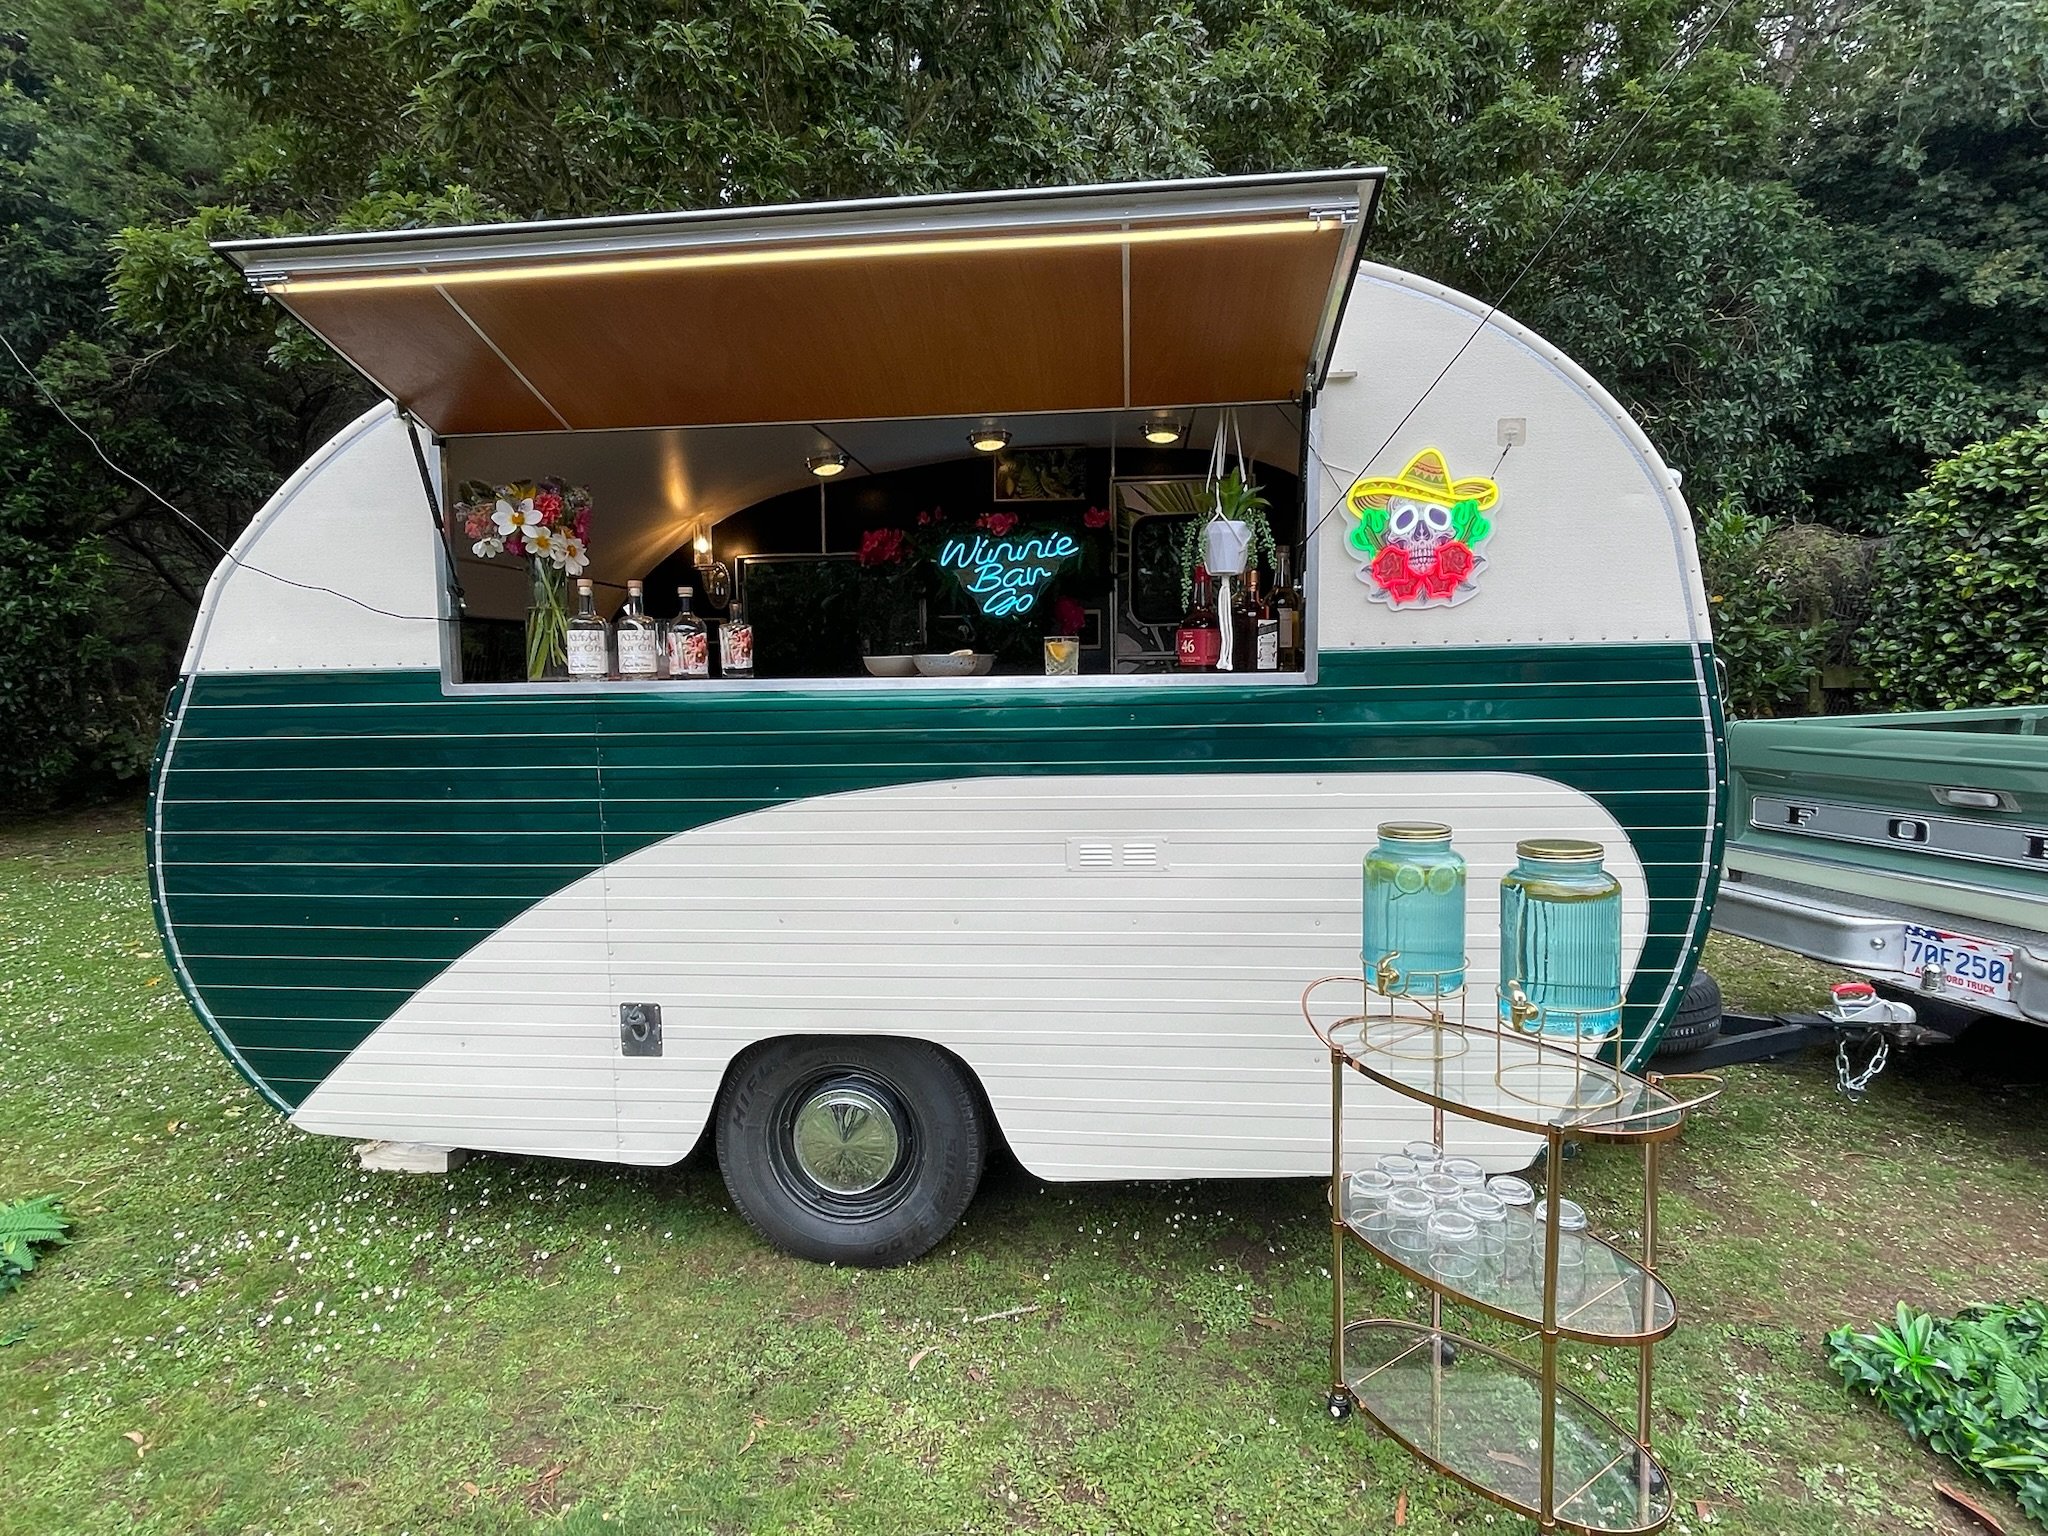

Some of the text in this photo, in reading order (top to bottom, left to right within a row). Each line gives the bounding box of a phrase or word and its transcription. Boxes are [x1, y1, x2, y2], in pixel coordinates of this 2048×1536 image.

[940, 531, 1080, 568] Winnie
[967, 563, 1052, 592] Bar
[983, 588, 1034, 616] Go
[1181, 639, 1195, 653] 46
[1910, 940, 2005, 984] 70F250
[1966, 979, 1995, 995] TRUCK
